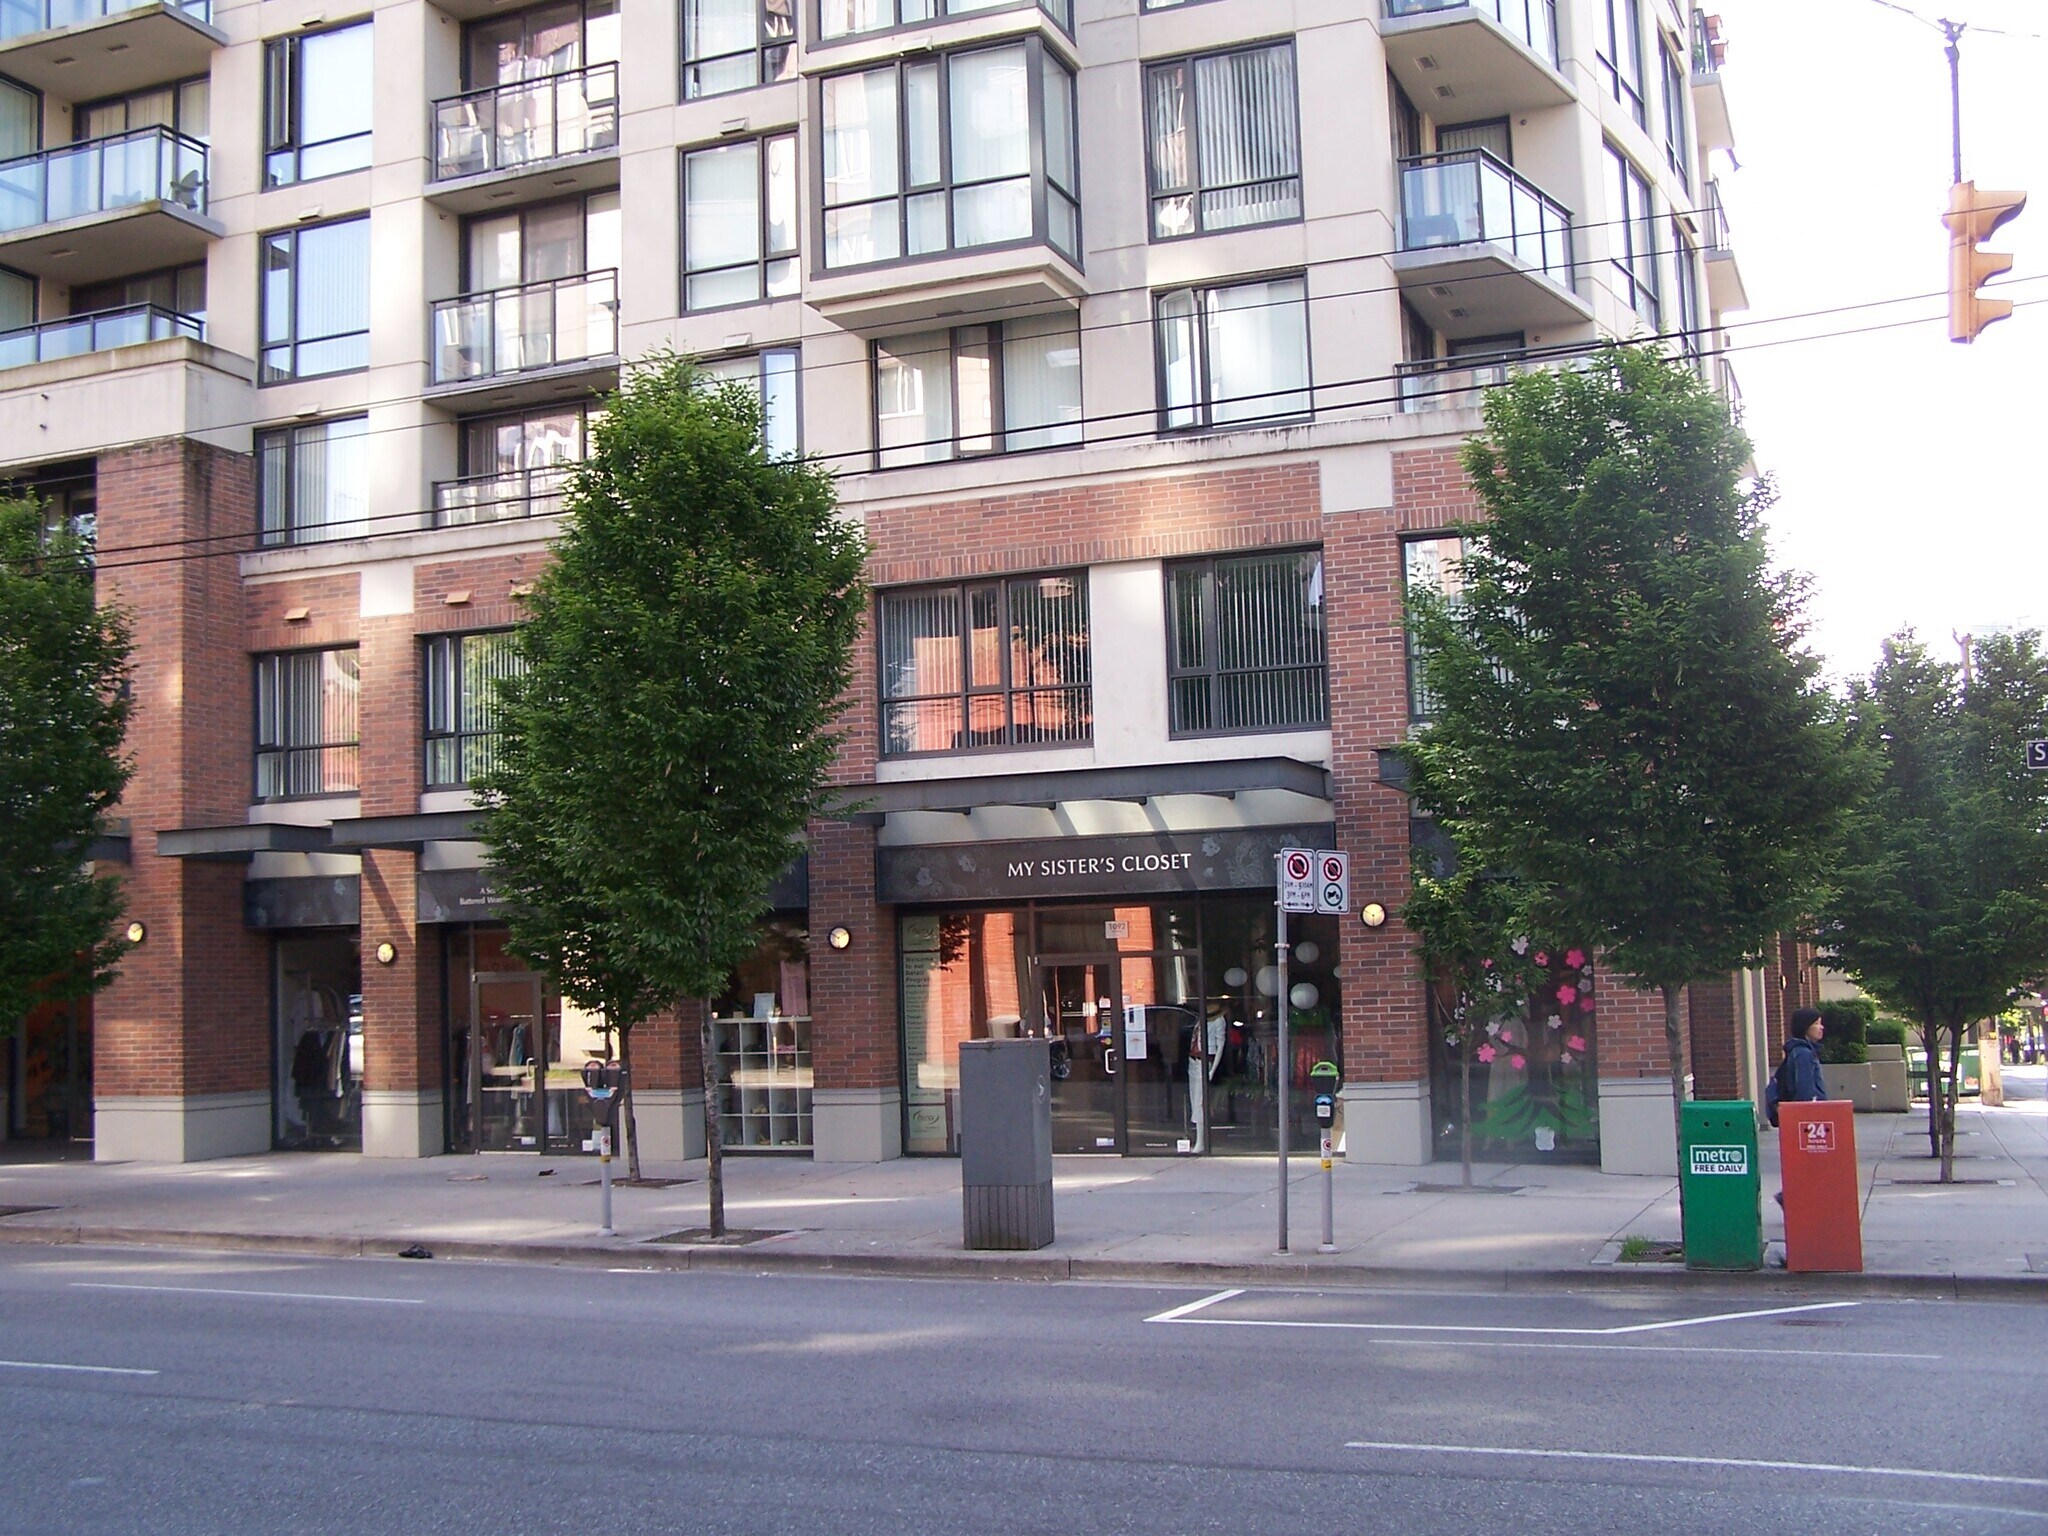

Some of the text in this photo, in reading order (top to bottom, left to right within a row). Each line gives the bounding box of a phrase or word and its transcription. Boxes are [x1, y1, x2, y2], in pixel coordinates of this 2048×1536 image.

[1008, 853, 1192, 877] MY SISTER'S CLOSET
[1108, 922, 1126, 931] 1092
[1807, 1123, 1826, 1138] 24
[1695, 1148, 1743, 1163] metro
[1694, 1164, 1743, 1173] FREE DAILY
